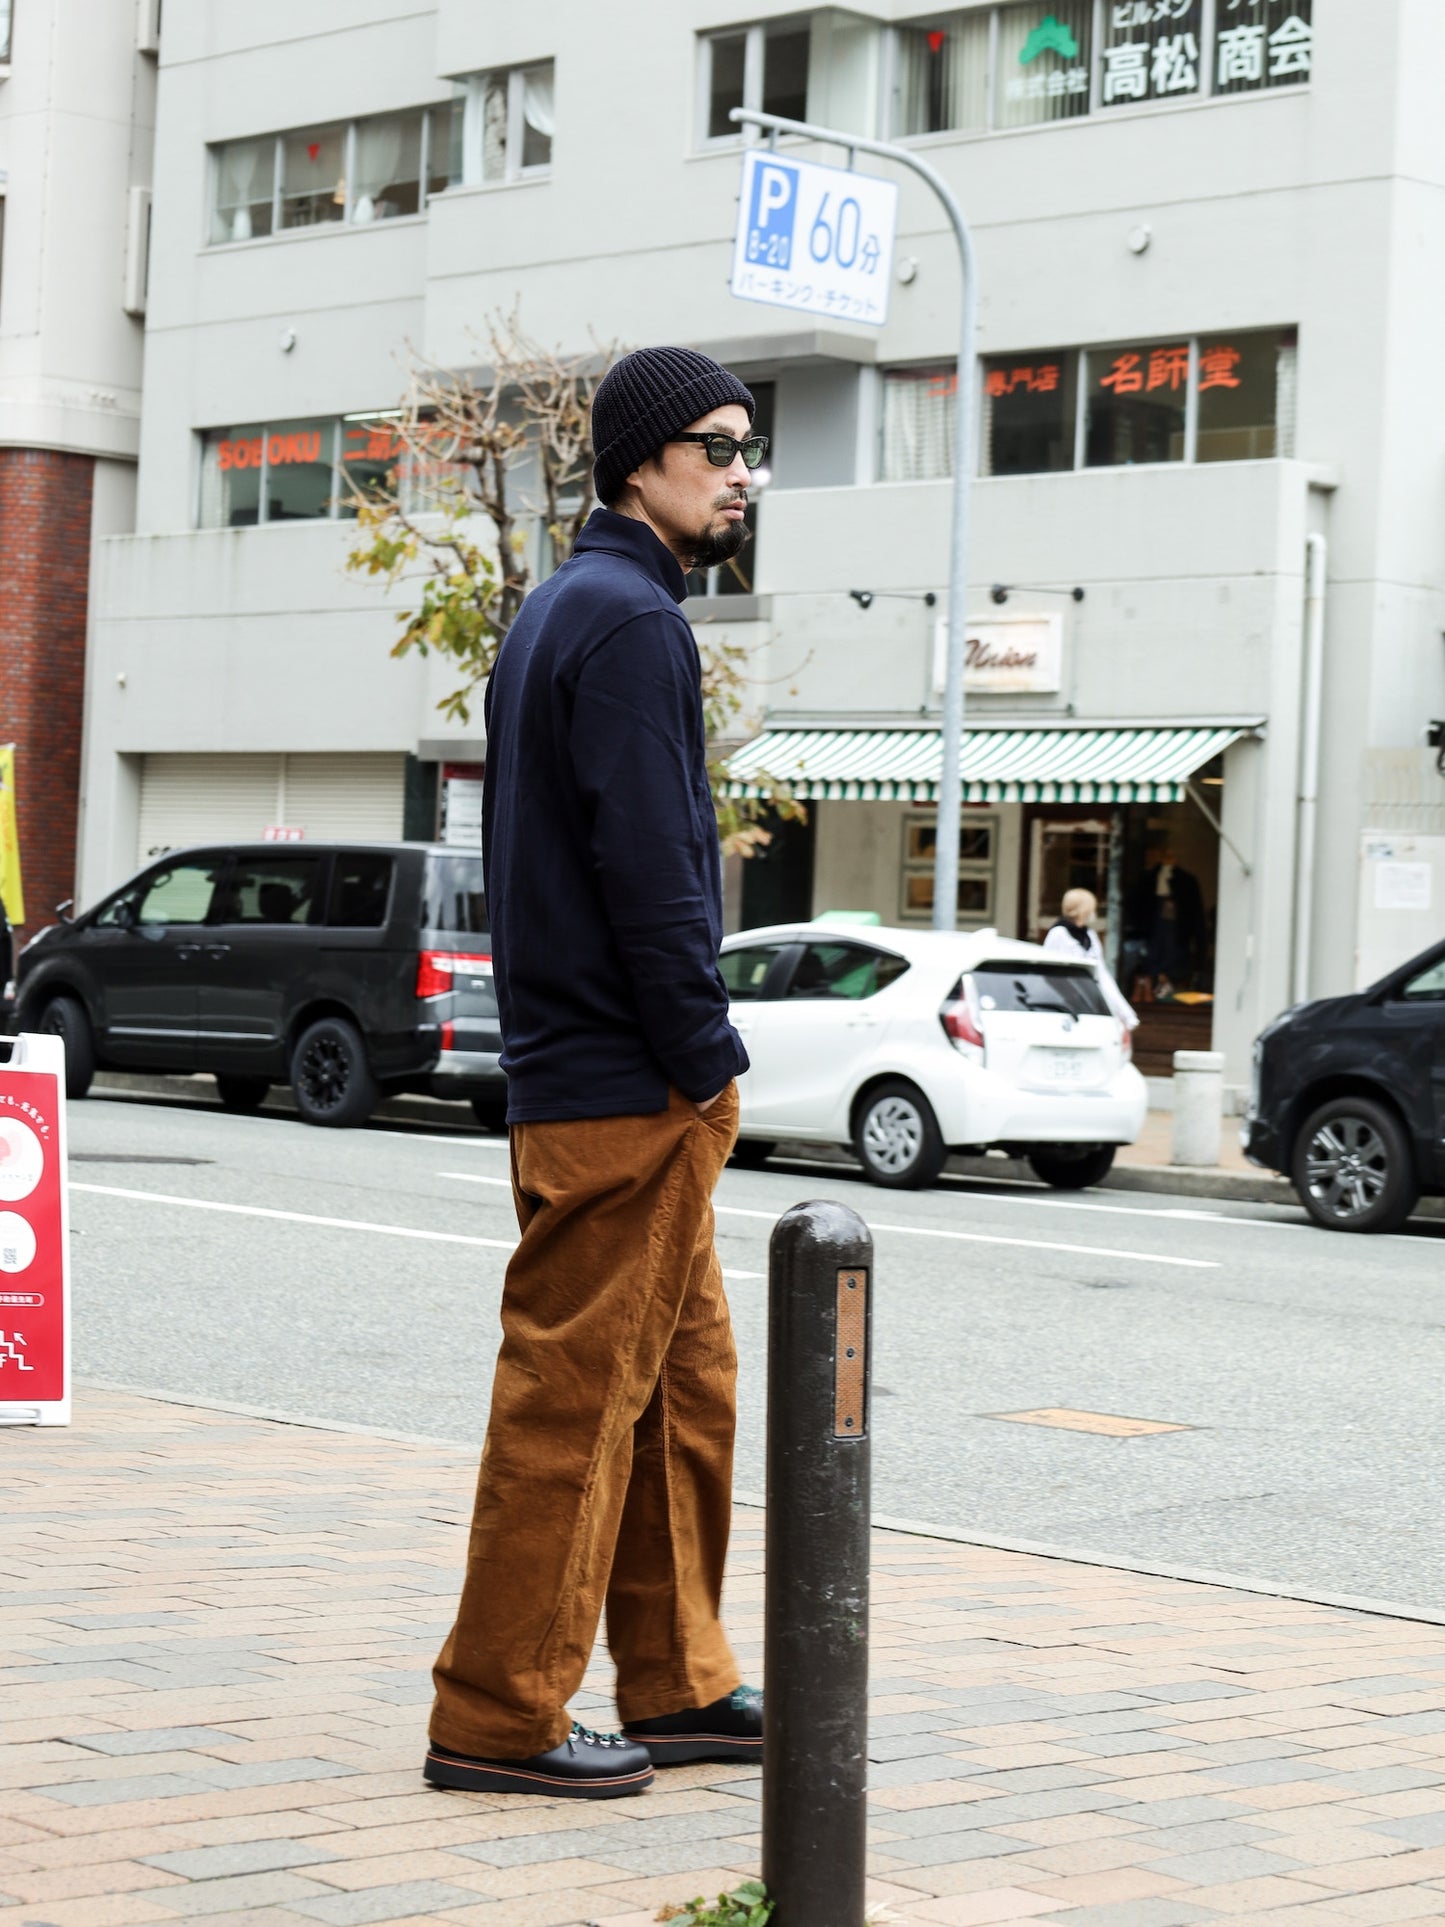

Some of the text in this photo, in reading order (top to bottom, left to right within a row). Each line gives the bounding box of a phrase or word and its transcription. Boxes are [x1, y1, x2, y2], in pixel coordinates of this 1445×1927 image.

[758, 166, 792, 229] P
[747, 229, 790, 267] 8-20
[809, 191, 881, 275] 60分
[218, 431, 321, 471] SOBOKU
